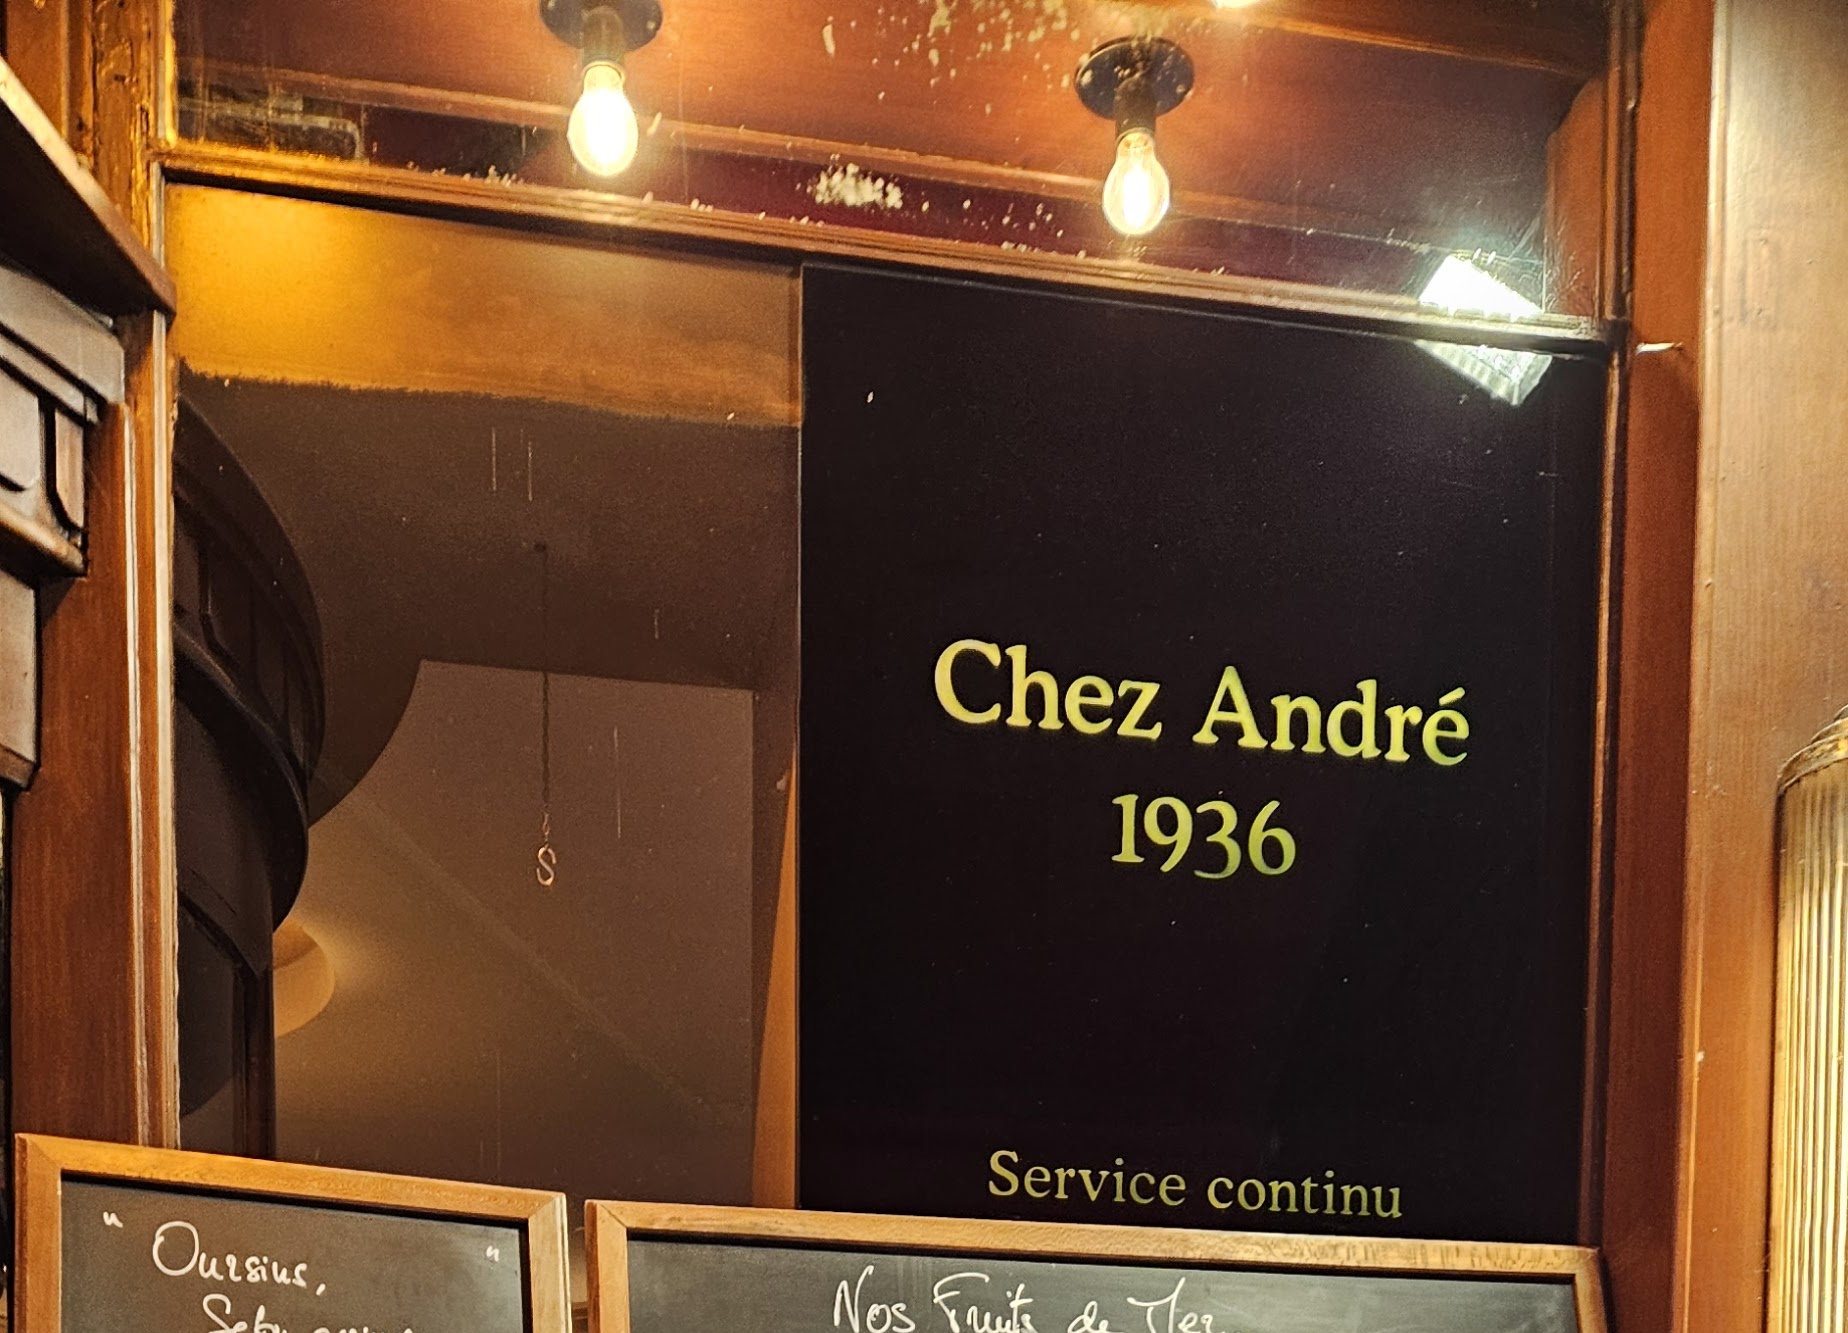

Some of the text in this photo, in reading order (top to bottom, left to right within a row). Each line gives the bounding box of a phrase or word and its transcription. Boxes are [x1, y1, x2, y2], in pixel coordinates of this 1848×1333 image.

[934, 639, 1471, 767] Chez André
[1111, 794, 1297, 879] 1936
[988, 1151, 1403, 1219] Service continu
